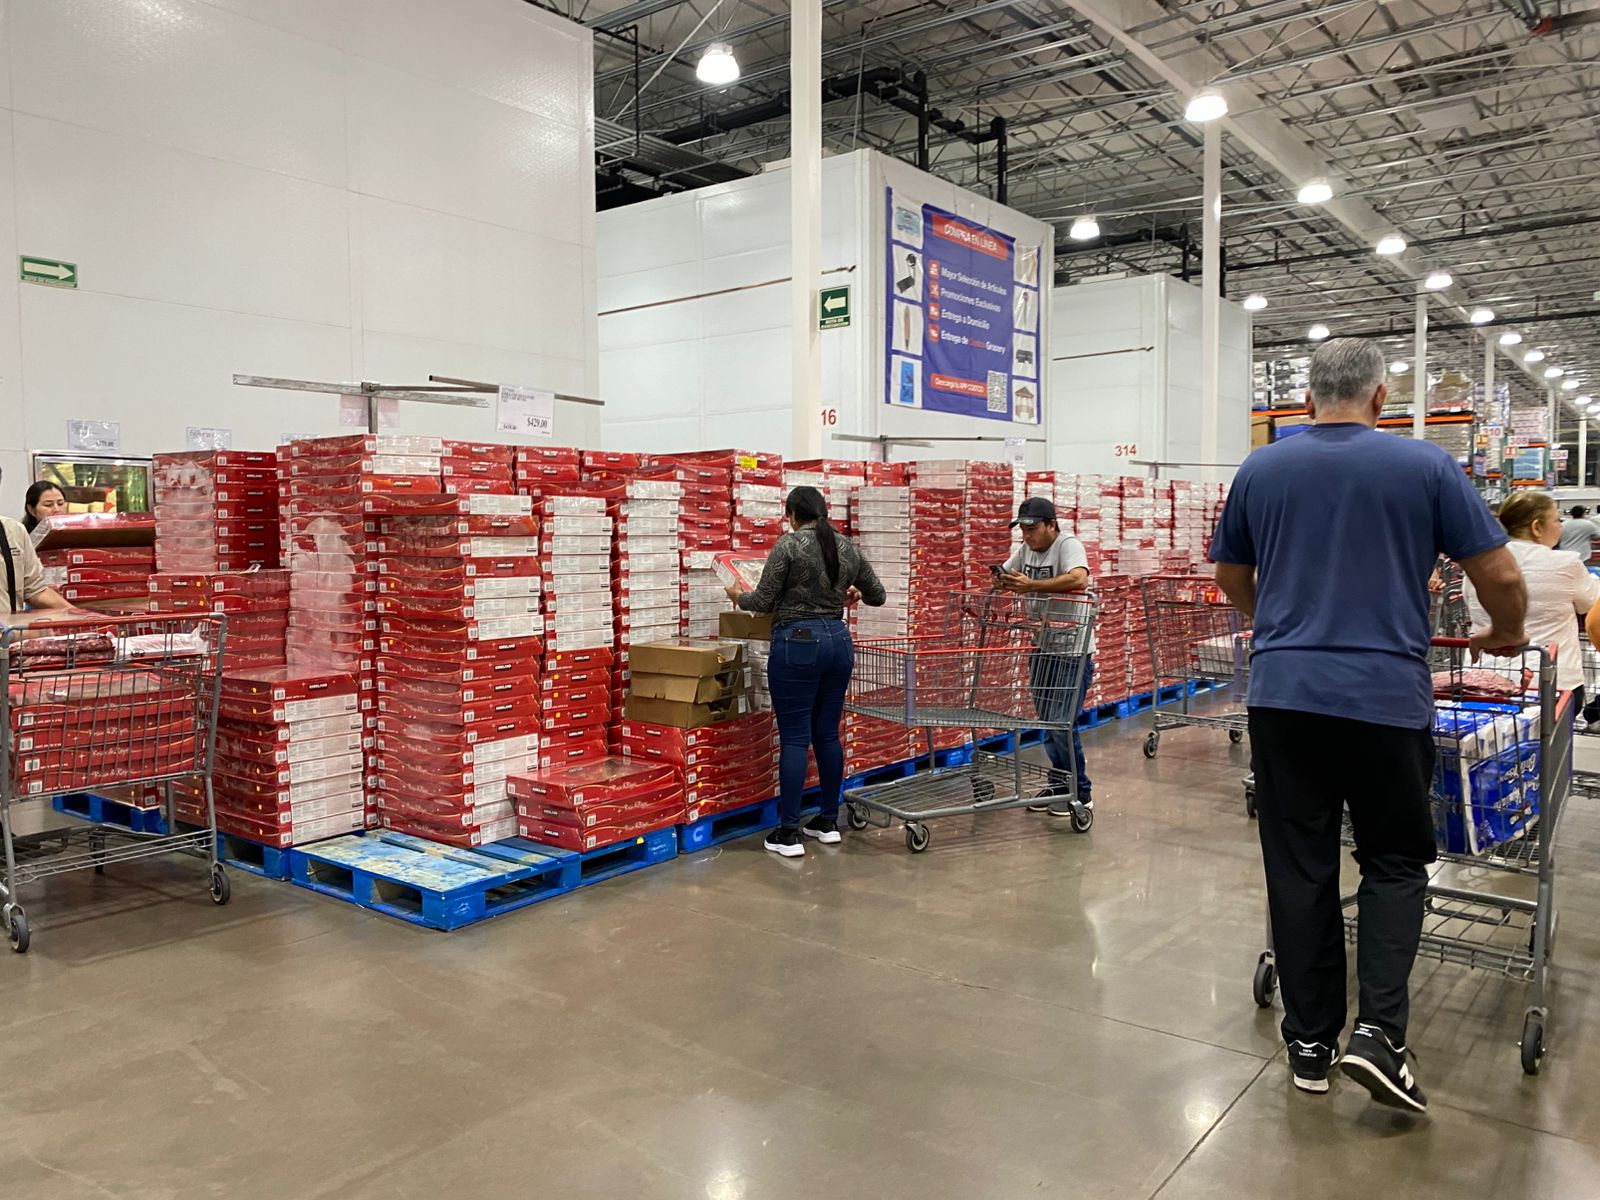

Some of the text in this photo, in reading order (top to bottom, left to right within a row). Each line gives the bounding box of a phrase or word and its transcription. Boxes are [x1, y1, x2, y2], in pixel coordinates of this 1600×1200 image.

[941, 267, 957, 280] Mejor
[941, 288, 1001, 312] Promociones Exclusivas
[941, 309, 962, 323] Entrega
[967, 315, 990, 330] Domicilio
[941, 330, 961, 345] Entrega
[986, 341, 1006, 355] Grocery
[527, 416, 548, 429] $429.00
[821, 409, 837, 426] 16
[1115, 443, 1137, 457] 314
[532, 786, 547, 795] KIRKLAND
[544, 829, 559, 837] KIRKLAND
